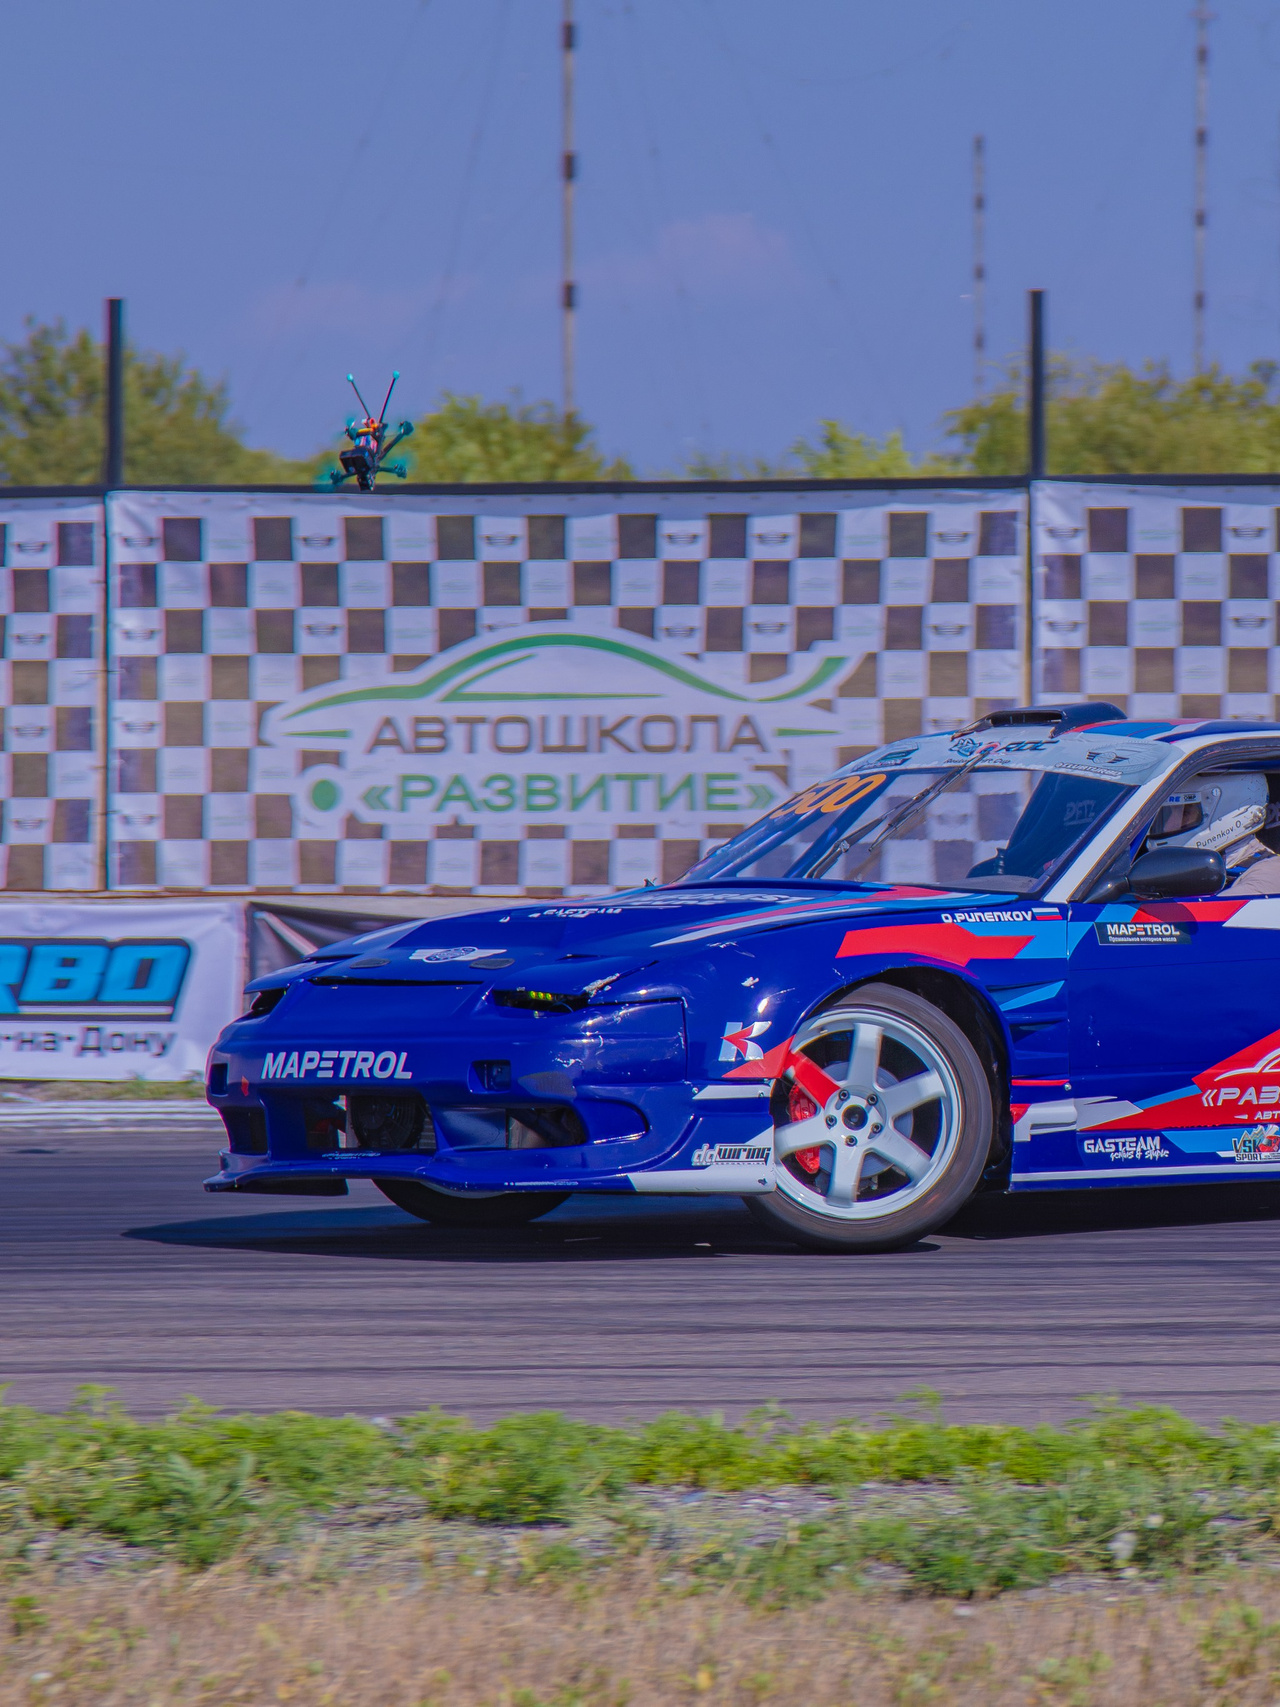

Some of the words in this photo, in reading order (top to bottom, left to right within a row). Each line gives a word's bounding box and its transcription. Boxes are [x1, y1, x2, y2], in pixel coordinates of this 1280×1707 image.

[365, 715, 769, 754] АВТОШКОЛА
[362, 772, 776, 812] «РАЗВИТИЕ»
[769, 773, 887, 819] 500
[1106, 923, 1180, 936] MAPETROL
[261, 1051, 413, 1080] MAPETROL
[1084, 1136, 1161, 1154] GASTEAM
[1236, 1153, 1262, 1161] SPORT
